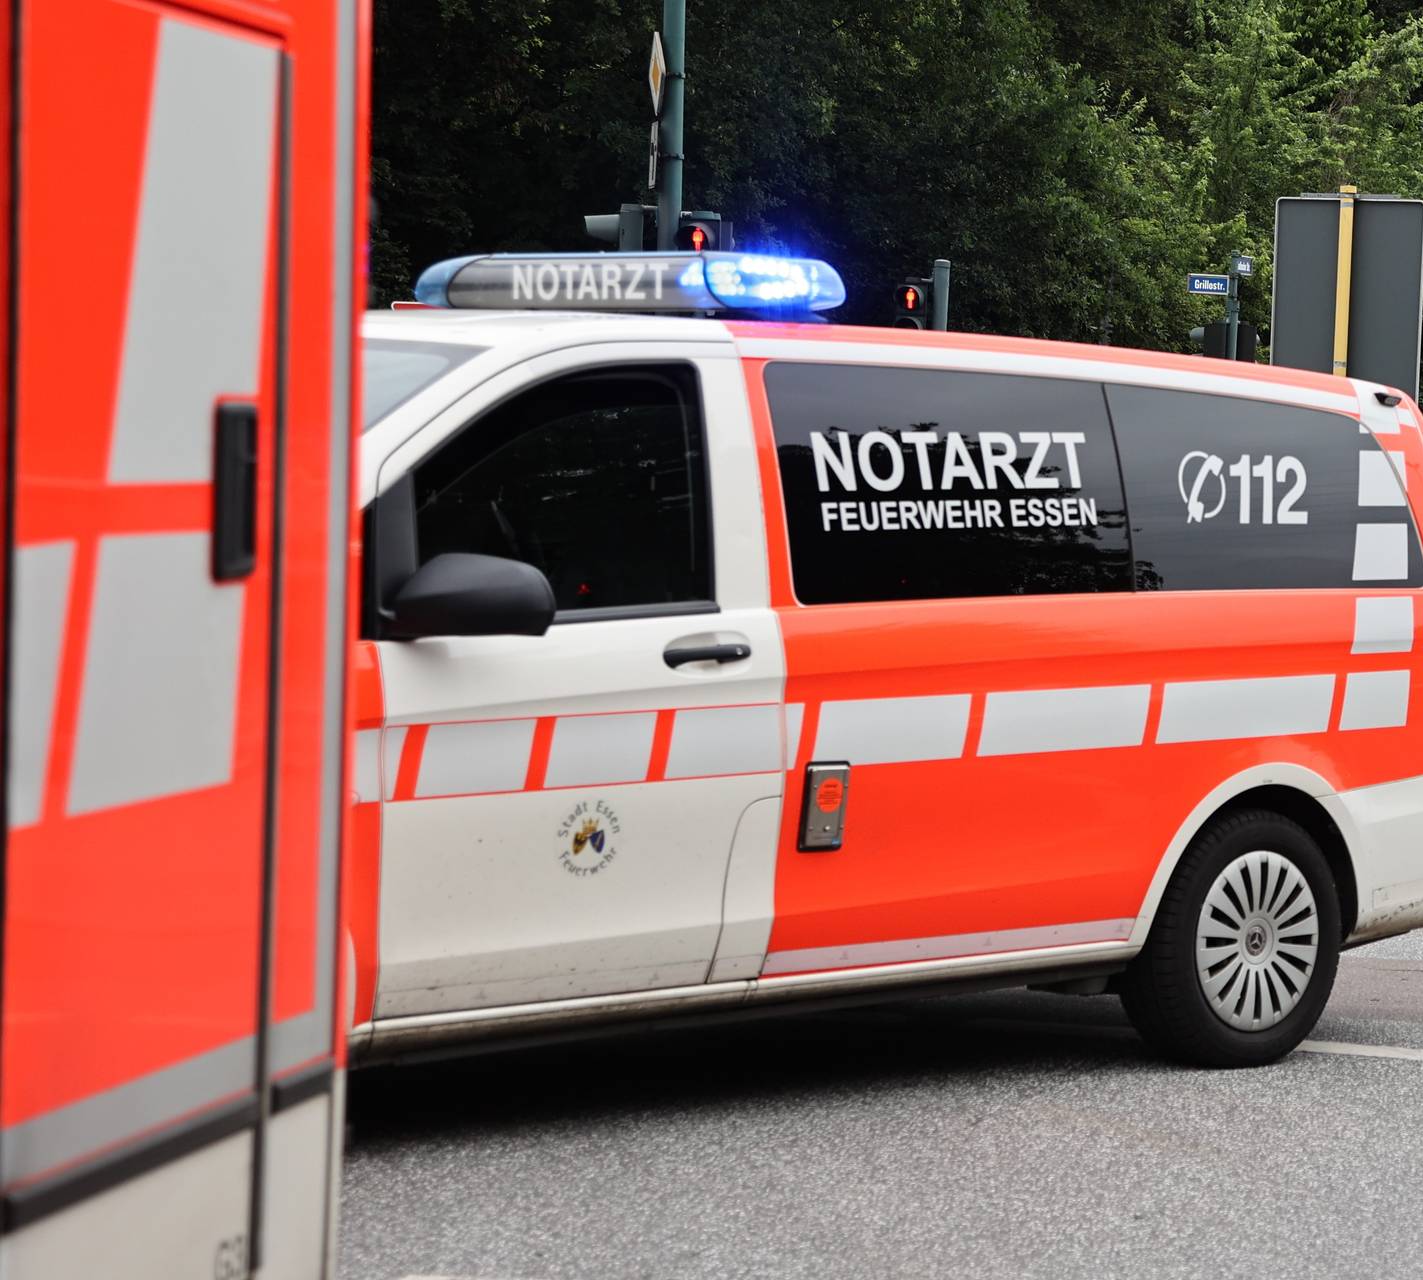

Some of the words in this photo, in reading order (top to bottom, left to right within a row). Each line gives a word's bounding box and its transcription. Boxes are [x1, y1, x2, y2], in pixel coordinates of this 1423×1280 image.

[512, 262, 669, 301] NOTARZT
[1194, 279, 1226, 291] Grillostr.
[810, 431, 1086, 493] NOTARZT
[1229, 454, 1309, 526] 112
[821, 499, 1004, 532] FEUERWEHR
[1010, 497, 1098, 528] ESSEN
[557, 801, 589, 838] Stadt
[596, 800, 621, 834] Essen
[558, 847, 617, 877] Feuerwehr
